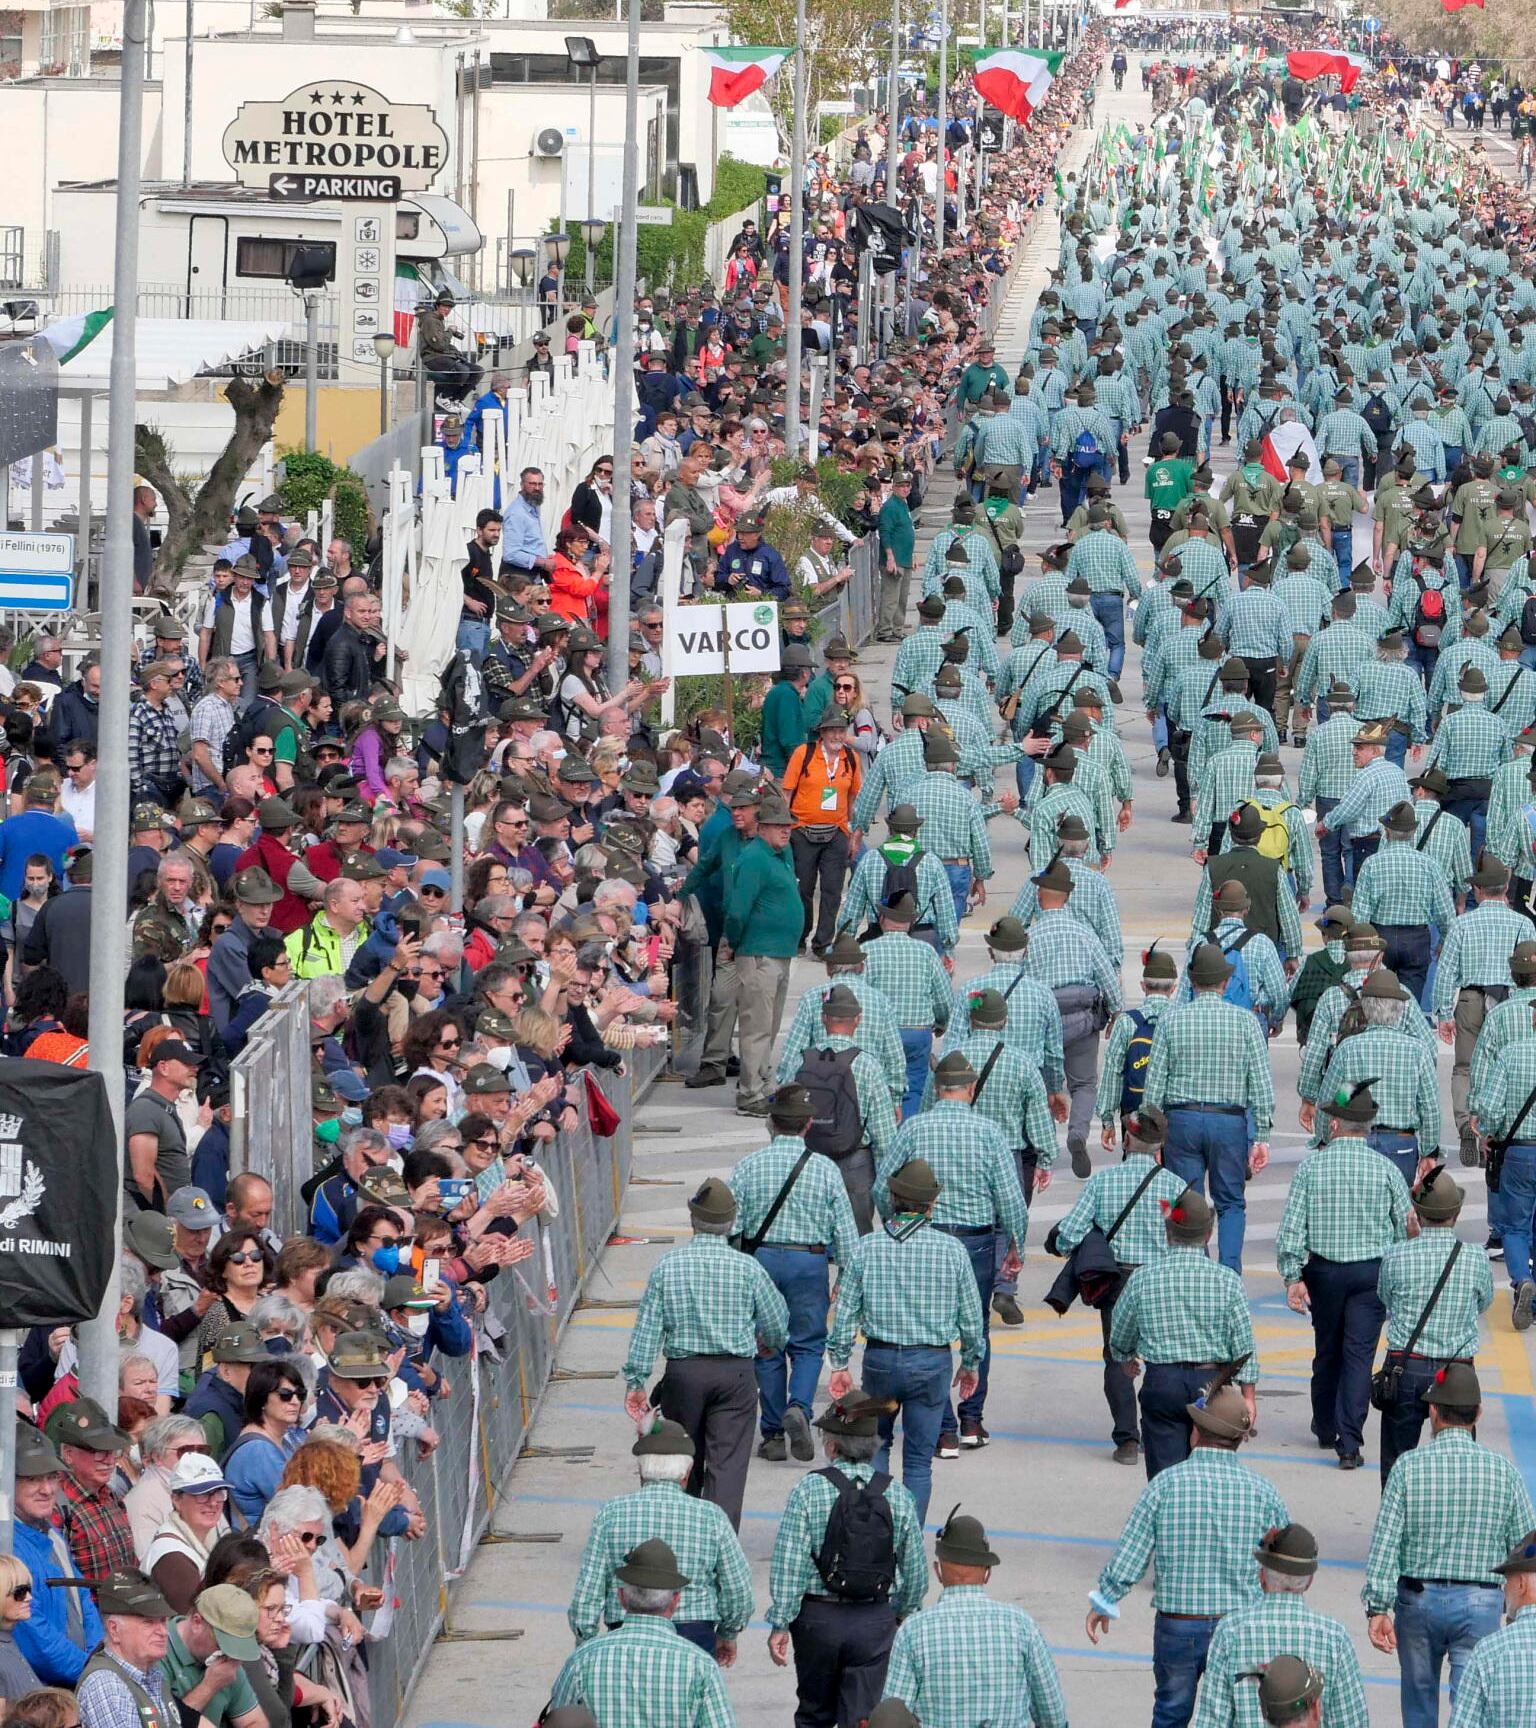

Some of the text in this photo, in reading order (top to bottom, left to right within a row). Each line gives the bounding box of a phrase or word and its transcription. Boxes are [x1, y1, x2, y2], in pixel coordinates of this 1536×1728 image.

[282, 111, 394, 138] HOTEL
[233, 140, 439, 169] METROPOLE
[304, 178, 394, 198] PARKING
[6, 539, 35, 552] Fellini
[37, 543, 65, 555] (1976)
[678, 628, 771, 655] VARCO
[0, 1237, 72, 1258] di RIMINI
